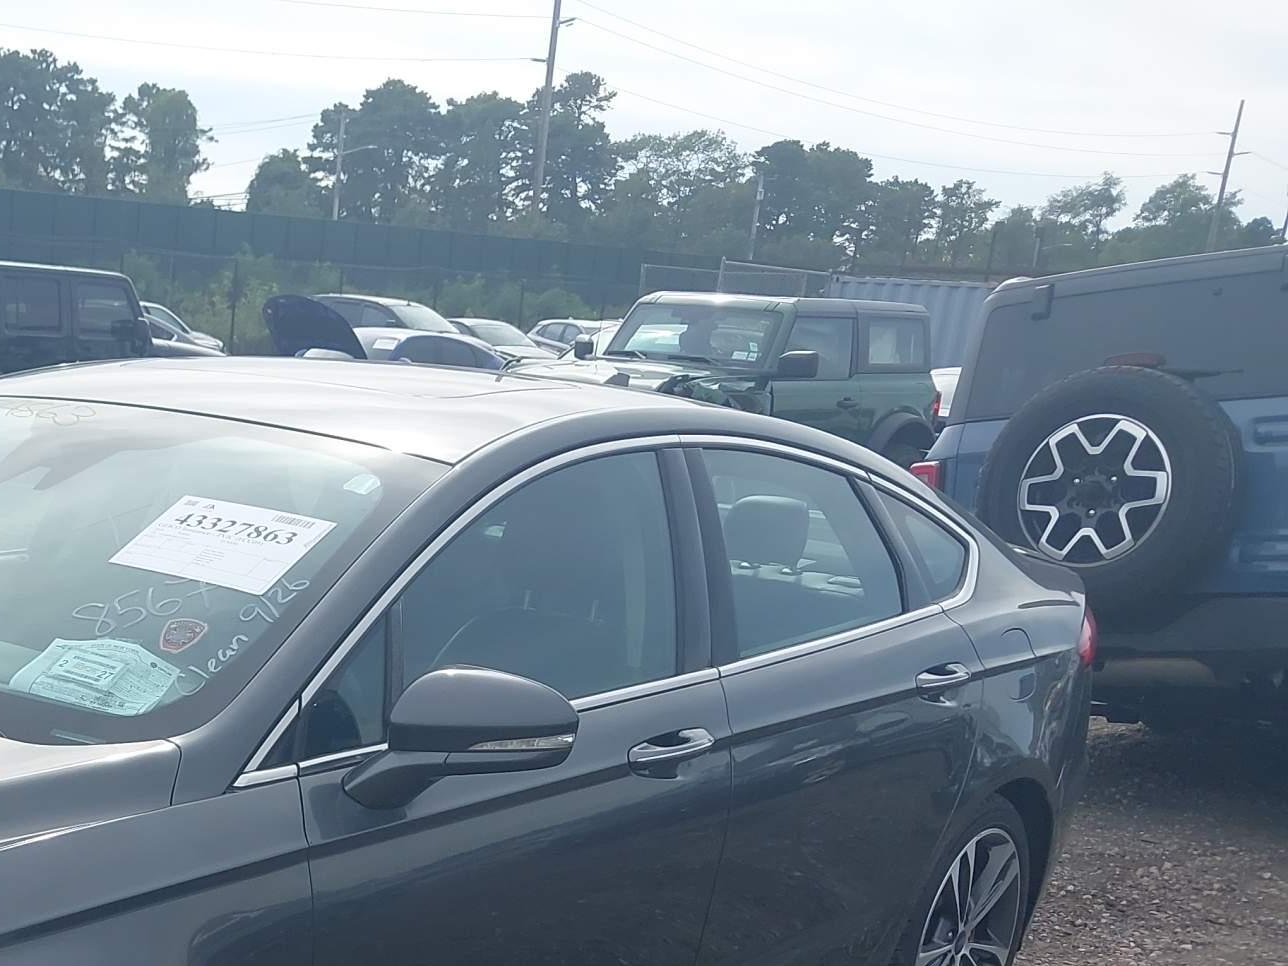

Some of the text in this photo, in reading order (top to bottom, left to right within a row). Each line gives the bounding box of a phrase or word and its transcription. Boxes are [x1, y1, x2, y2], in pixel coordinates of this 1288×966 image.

[175, 513, 298, 545] 43327863
[175, 577, 311, 695] Clean 9/26
